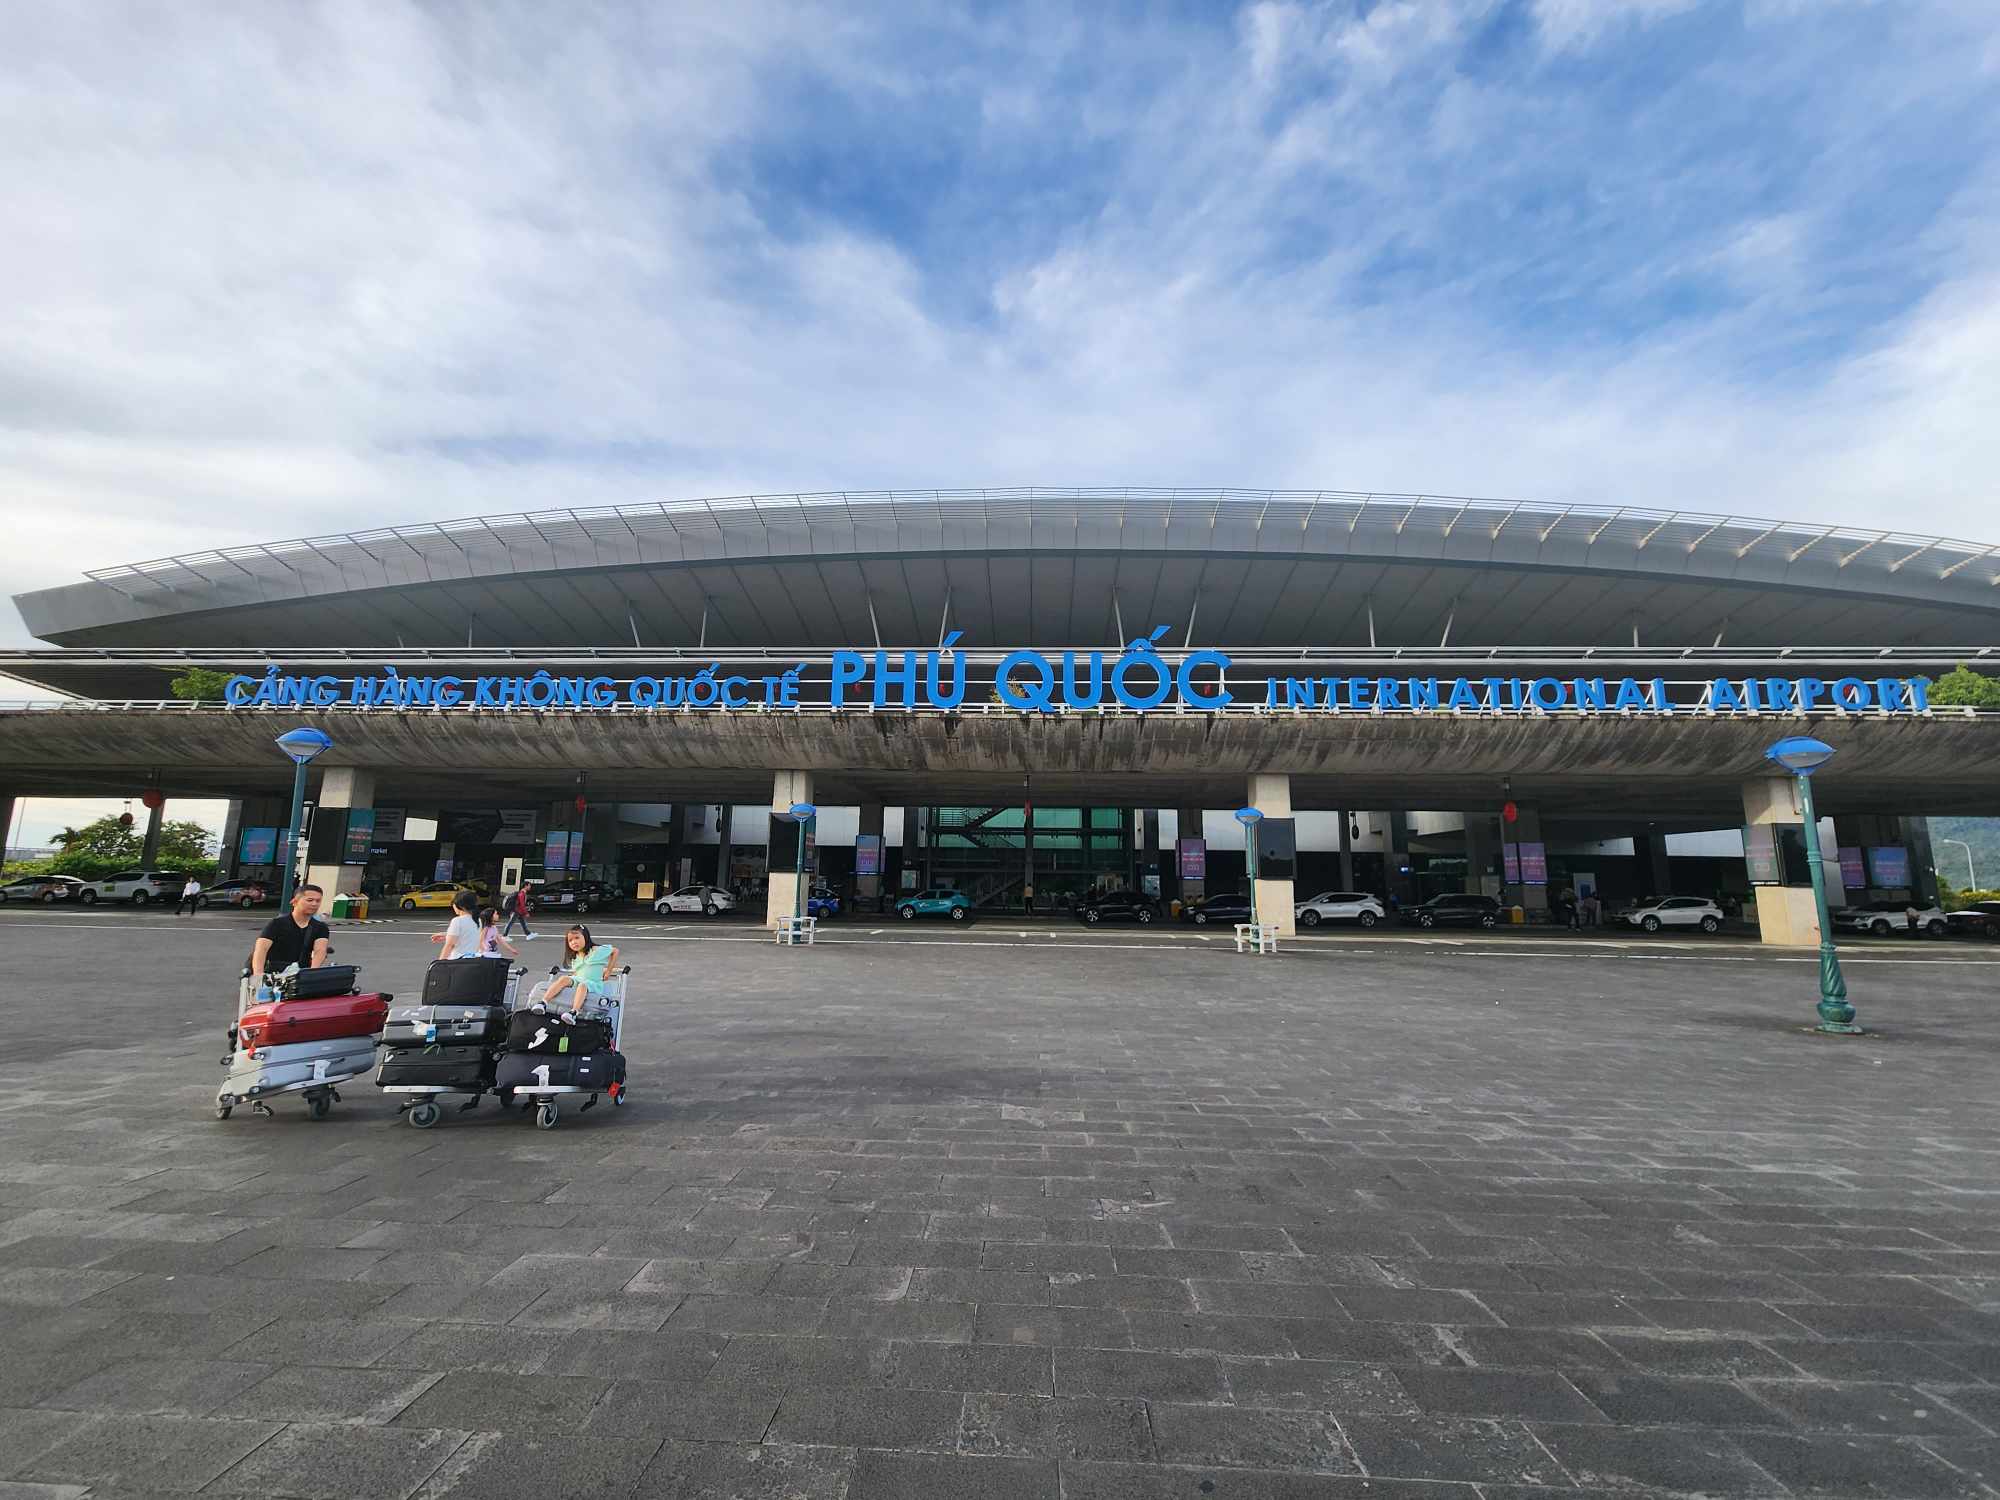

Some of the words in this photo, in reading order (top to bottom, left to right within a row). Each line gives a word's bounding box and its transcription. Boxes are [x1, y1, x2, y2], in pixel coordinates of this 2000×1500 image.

[224, 664, 341, 706] CẢNG
[351, 666, 464, 706] HÀNG
[475, 669, 617, 708] KHÔNG
[629, 662, 750, 708] QUỐC
[762, 663, 807, 707] TẾ
[831, 630, 967, 709] PHÚ
[995, 624, 1233, 713] QUỐC
[1266, 677, 1676, 711] INTERNATIONAL
[1709, 677, 1930, 711] AIRPORT
